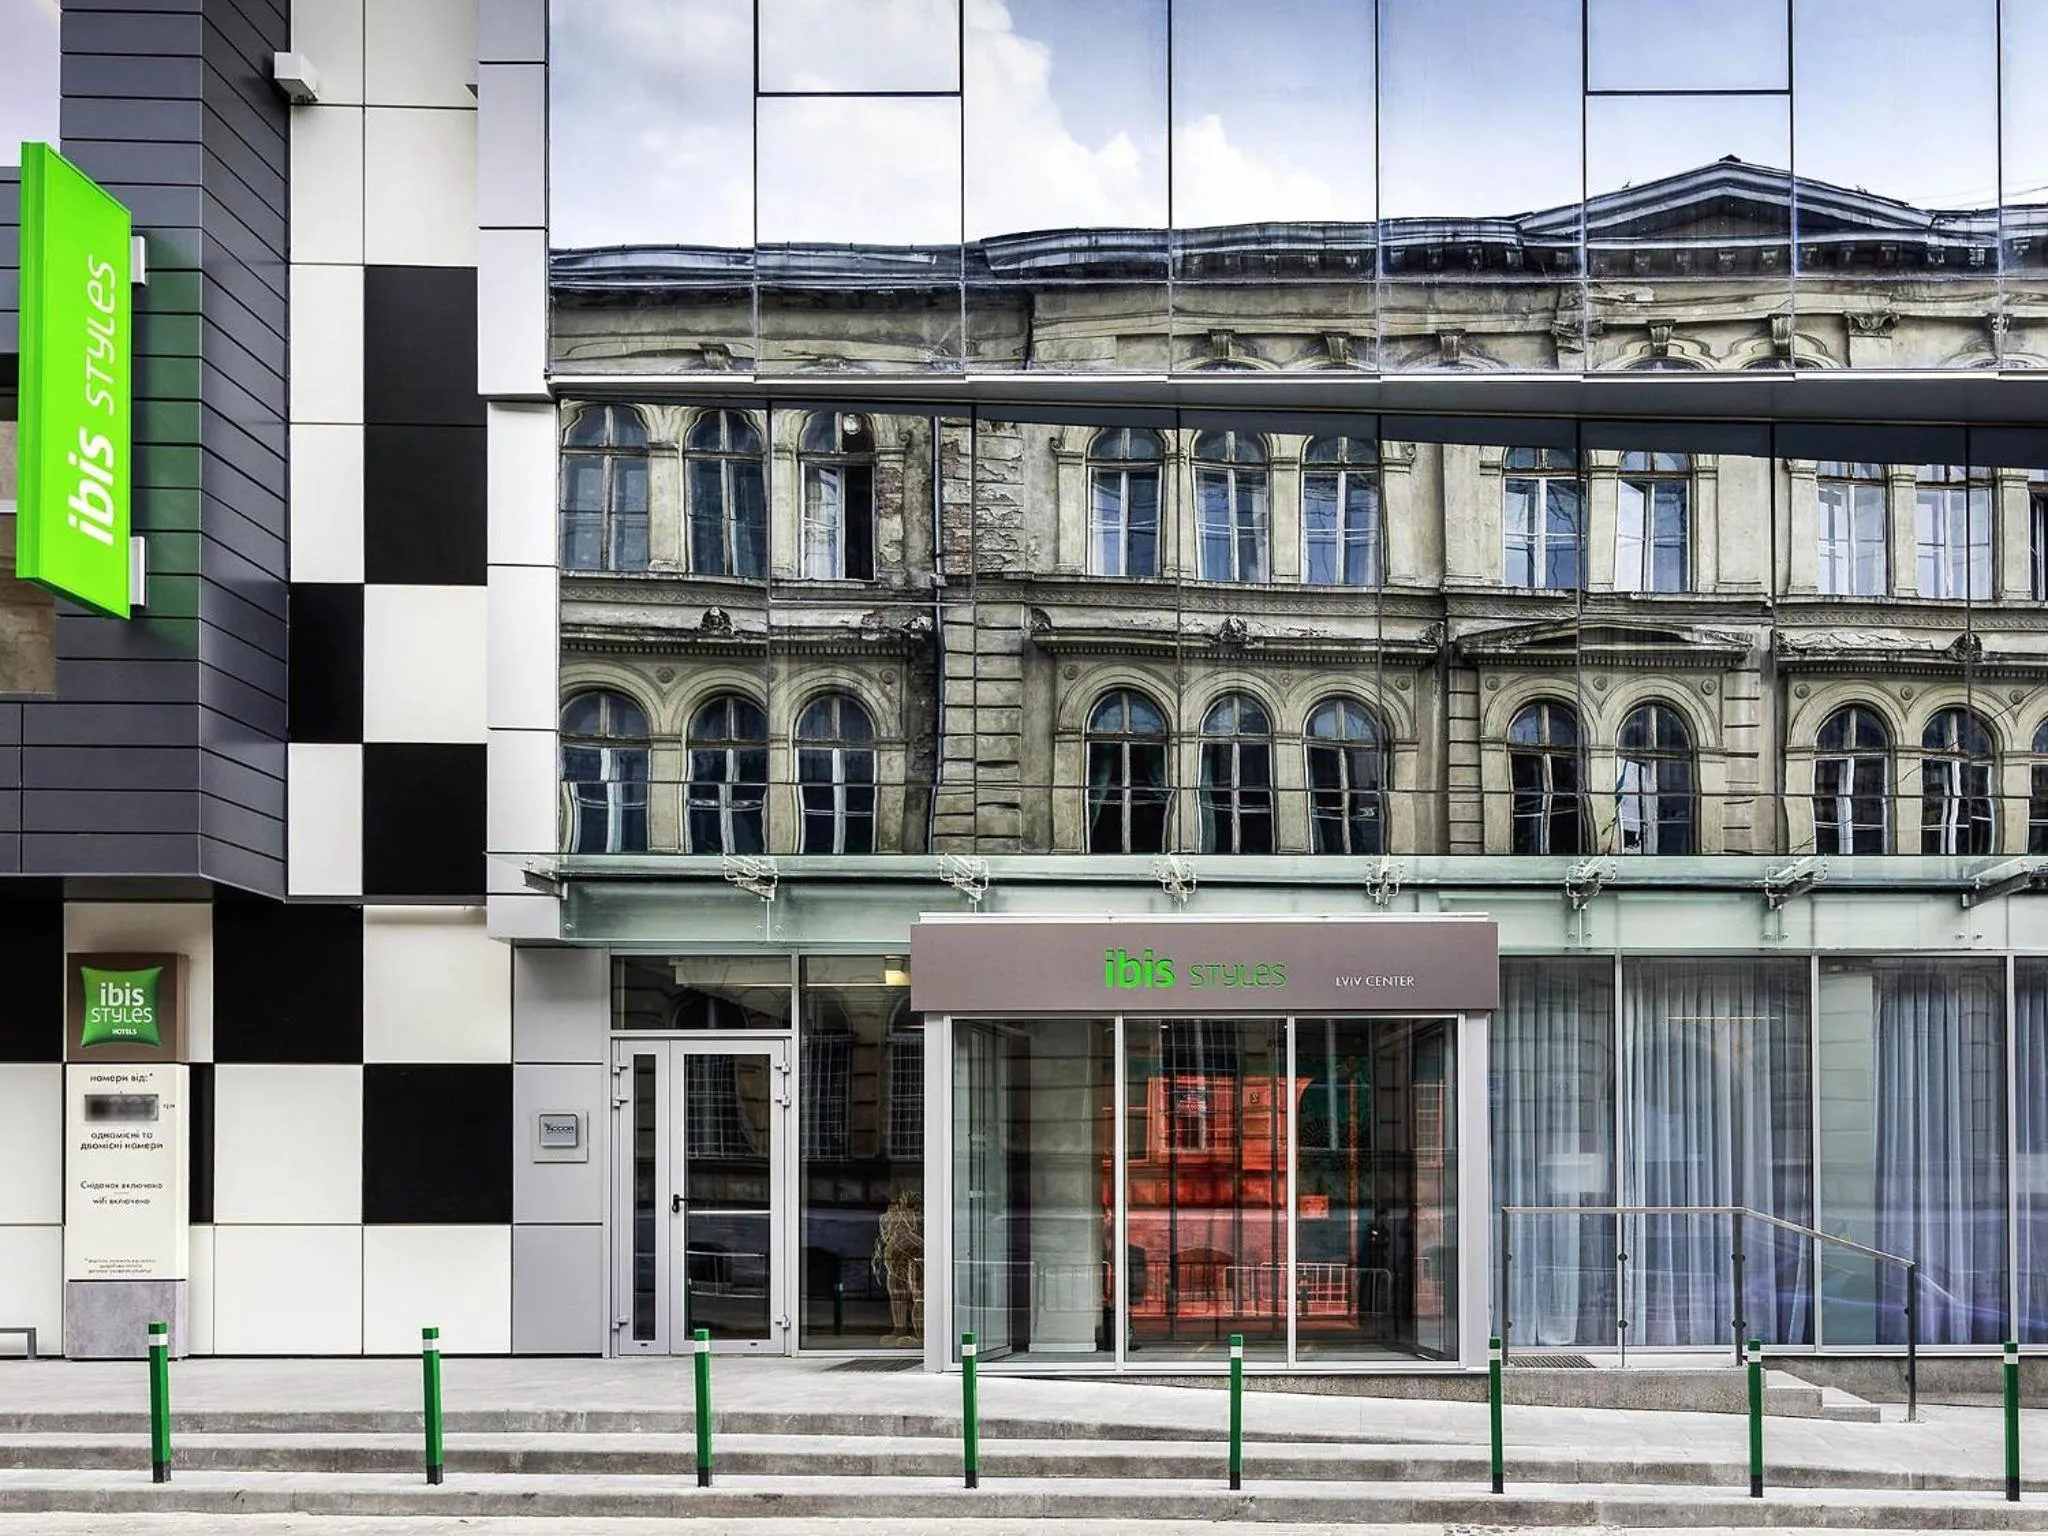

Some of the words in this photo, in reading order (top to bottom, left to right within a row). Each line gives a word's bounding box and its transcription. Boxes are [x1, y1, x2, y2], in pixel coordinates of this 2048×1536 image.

[67, 427, 115, 545] ibis
[1105, 949, 1176, 988] ibis
[1336, 975, 1361, 987] LVIV
[1366, 975, 1414, 987] CENTER
[100, 981, 144, 1007] ibis
[112, 1028, 138, 1036] HOTELS
[89, 1074, 128, 1085] номери
